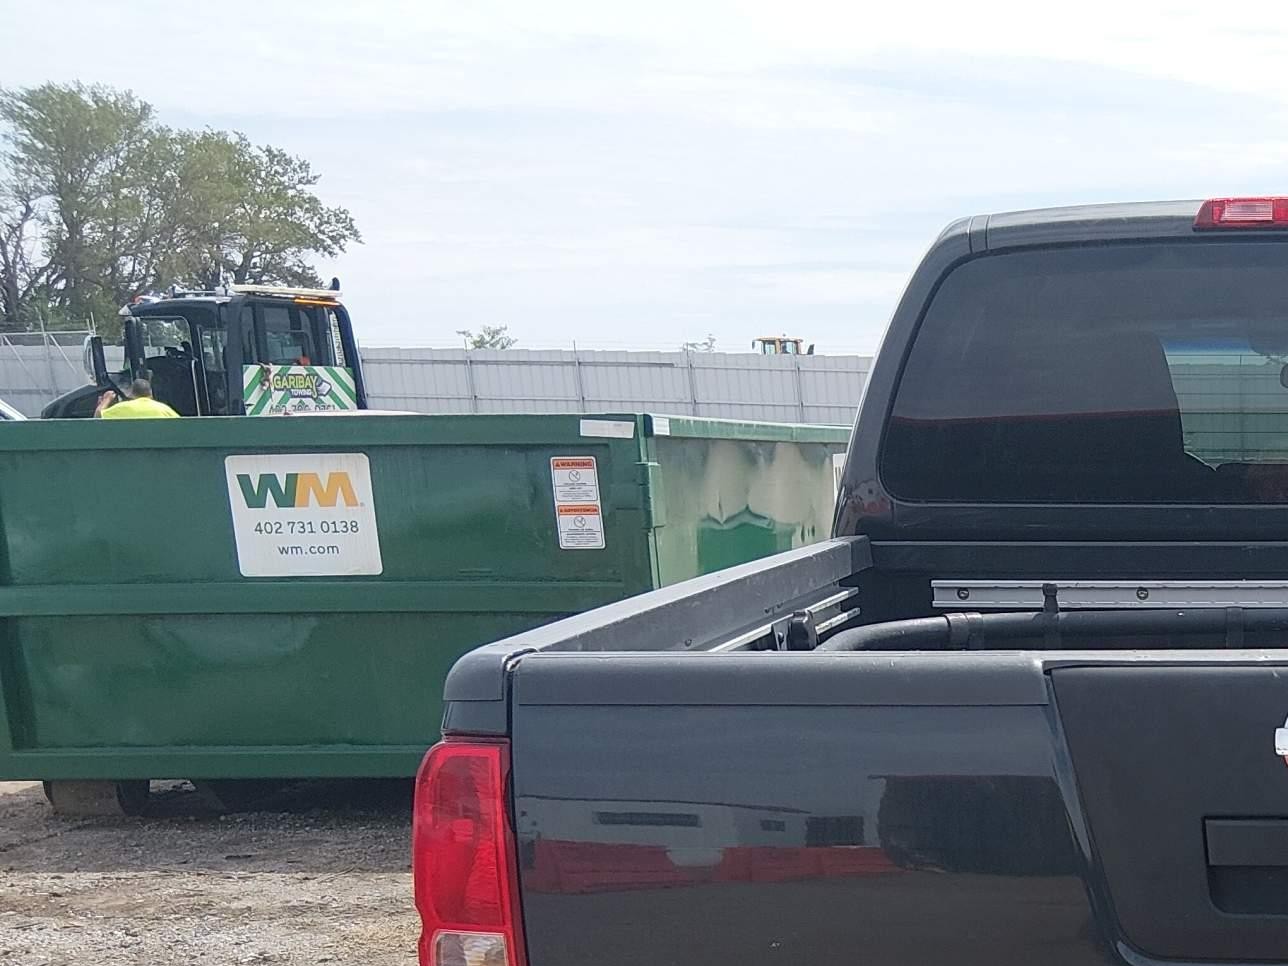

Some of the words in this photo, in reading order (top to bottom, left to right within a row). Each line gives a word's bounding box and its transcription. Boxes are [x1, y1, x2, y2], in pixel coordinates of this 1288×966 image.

[272, 374, 318, 399] GARIBAY
[236, 472, 360, 509] WM
[254, 521, 283, 535] 402
[287, 521, 316, 534] 731
[320, 520, 360, 534] 0138
[278, 544, 340, 556] wm.com
